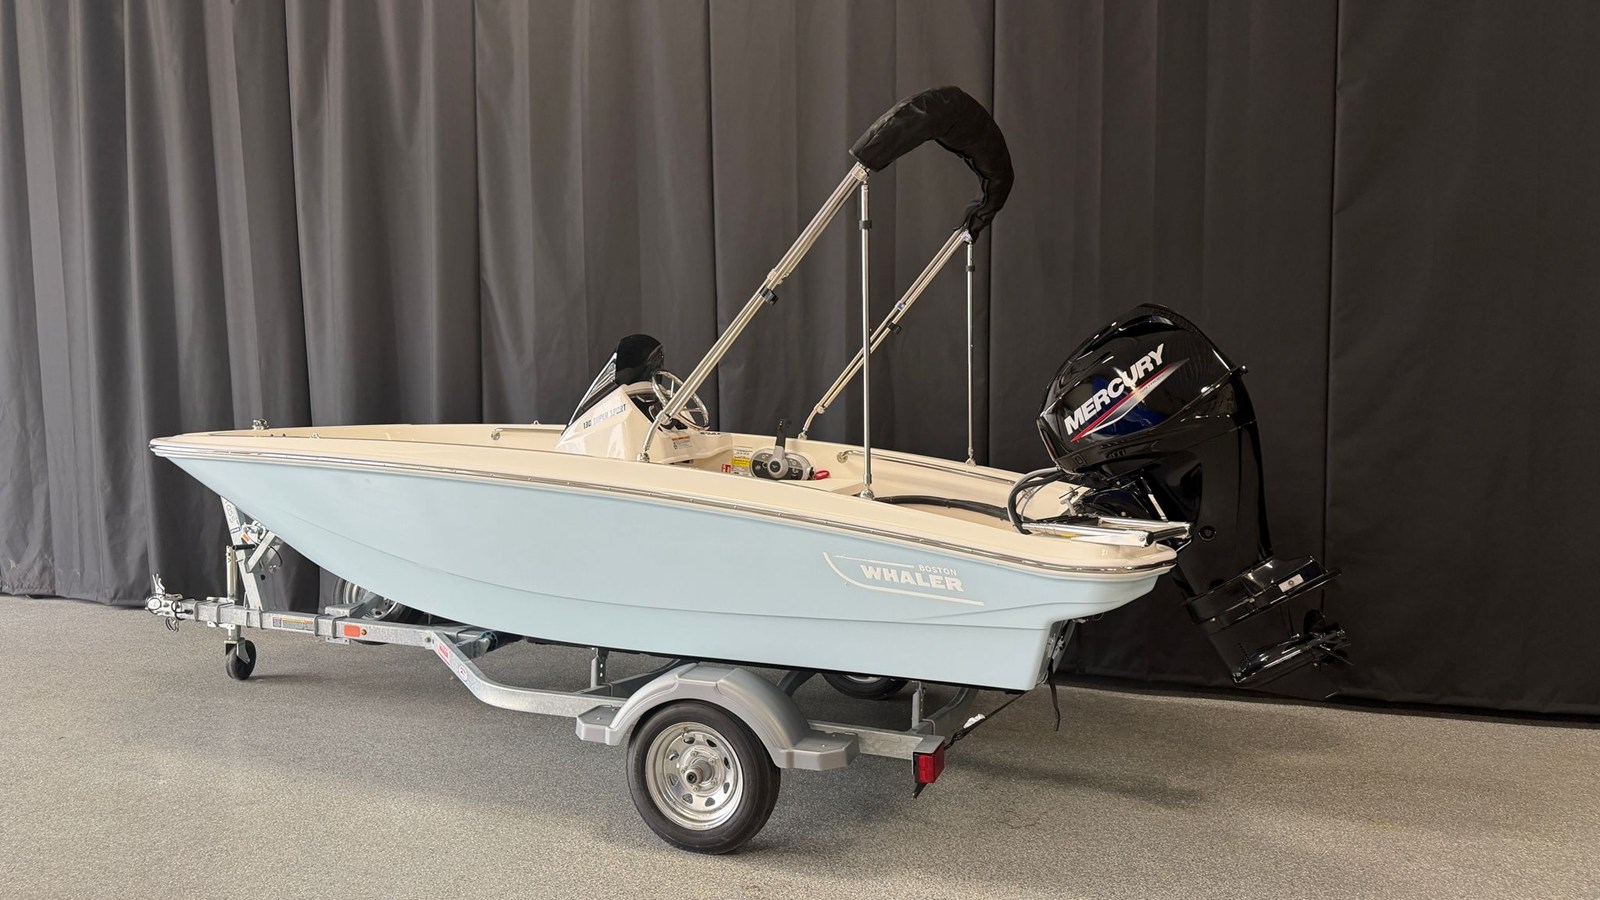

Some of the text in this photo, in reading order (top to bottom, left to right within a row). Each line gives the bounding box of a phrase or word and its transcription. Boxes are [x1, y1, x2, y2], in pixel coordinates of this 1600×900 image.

[1064, 343, 1164, 435] MERCURY
[860, 564, 965, 592] WHALER
[918, 564, 957, 576] BOSTON
